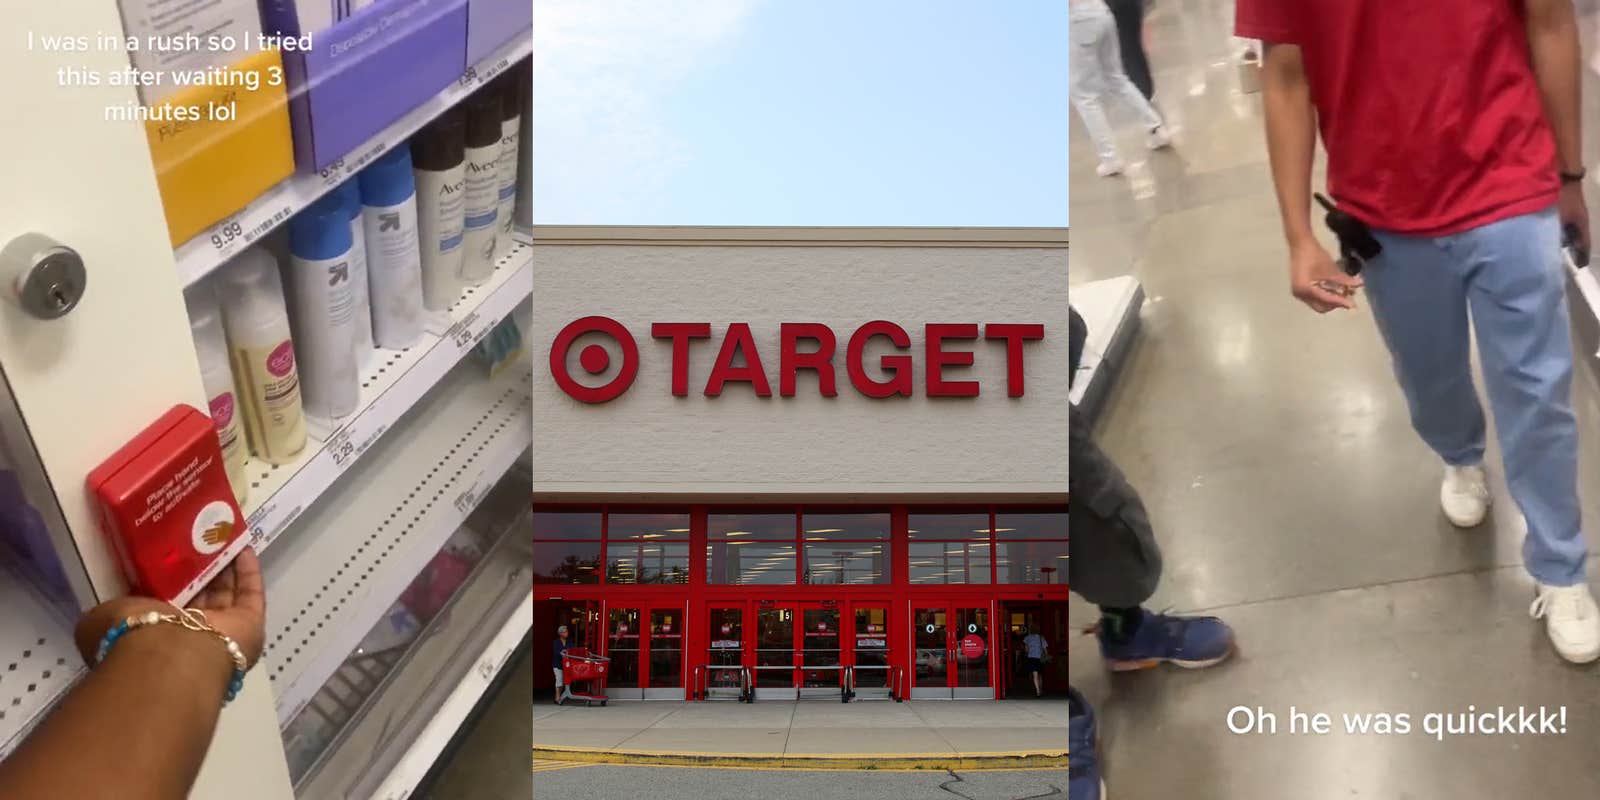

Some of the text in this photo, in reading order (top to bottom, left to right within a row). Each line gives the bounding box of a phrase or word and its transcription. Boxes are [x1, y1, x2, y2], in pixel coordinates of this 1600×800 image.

[211, 222, 242, 249] 9.99
[651, 320, 1045, 398] TARGET
[332, 441, 354, 465] 2.29
[135, 456, 213, 528] below the sensor
[147, 456, 199, 507] Place hand
[153, 480, 201, 523] to activate
